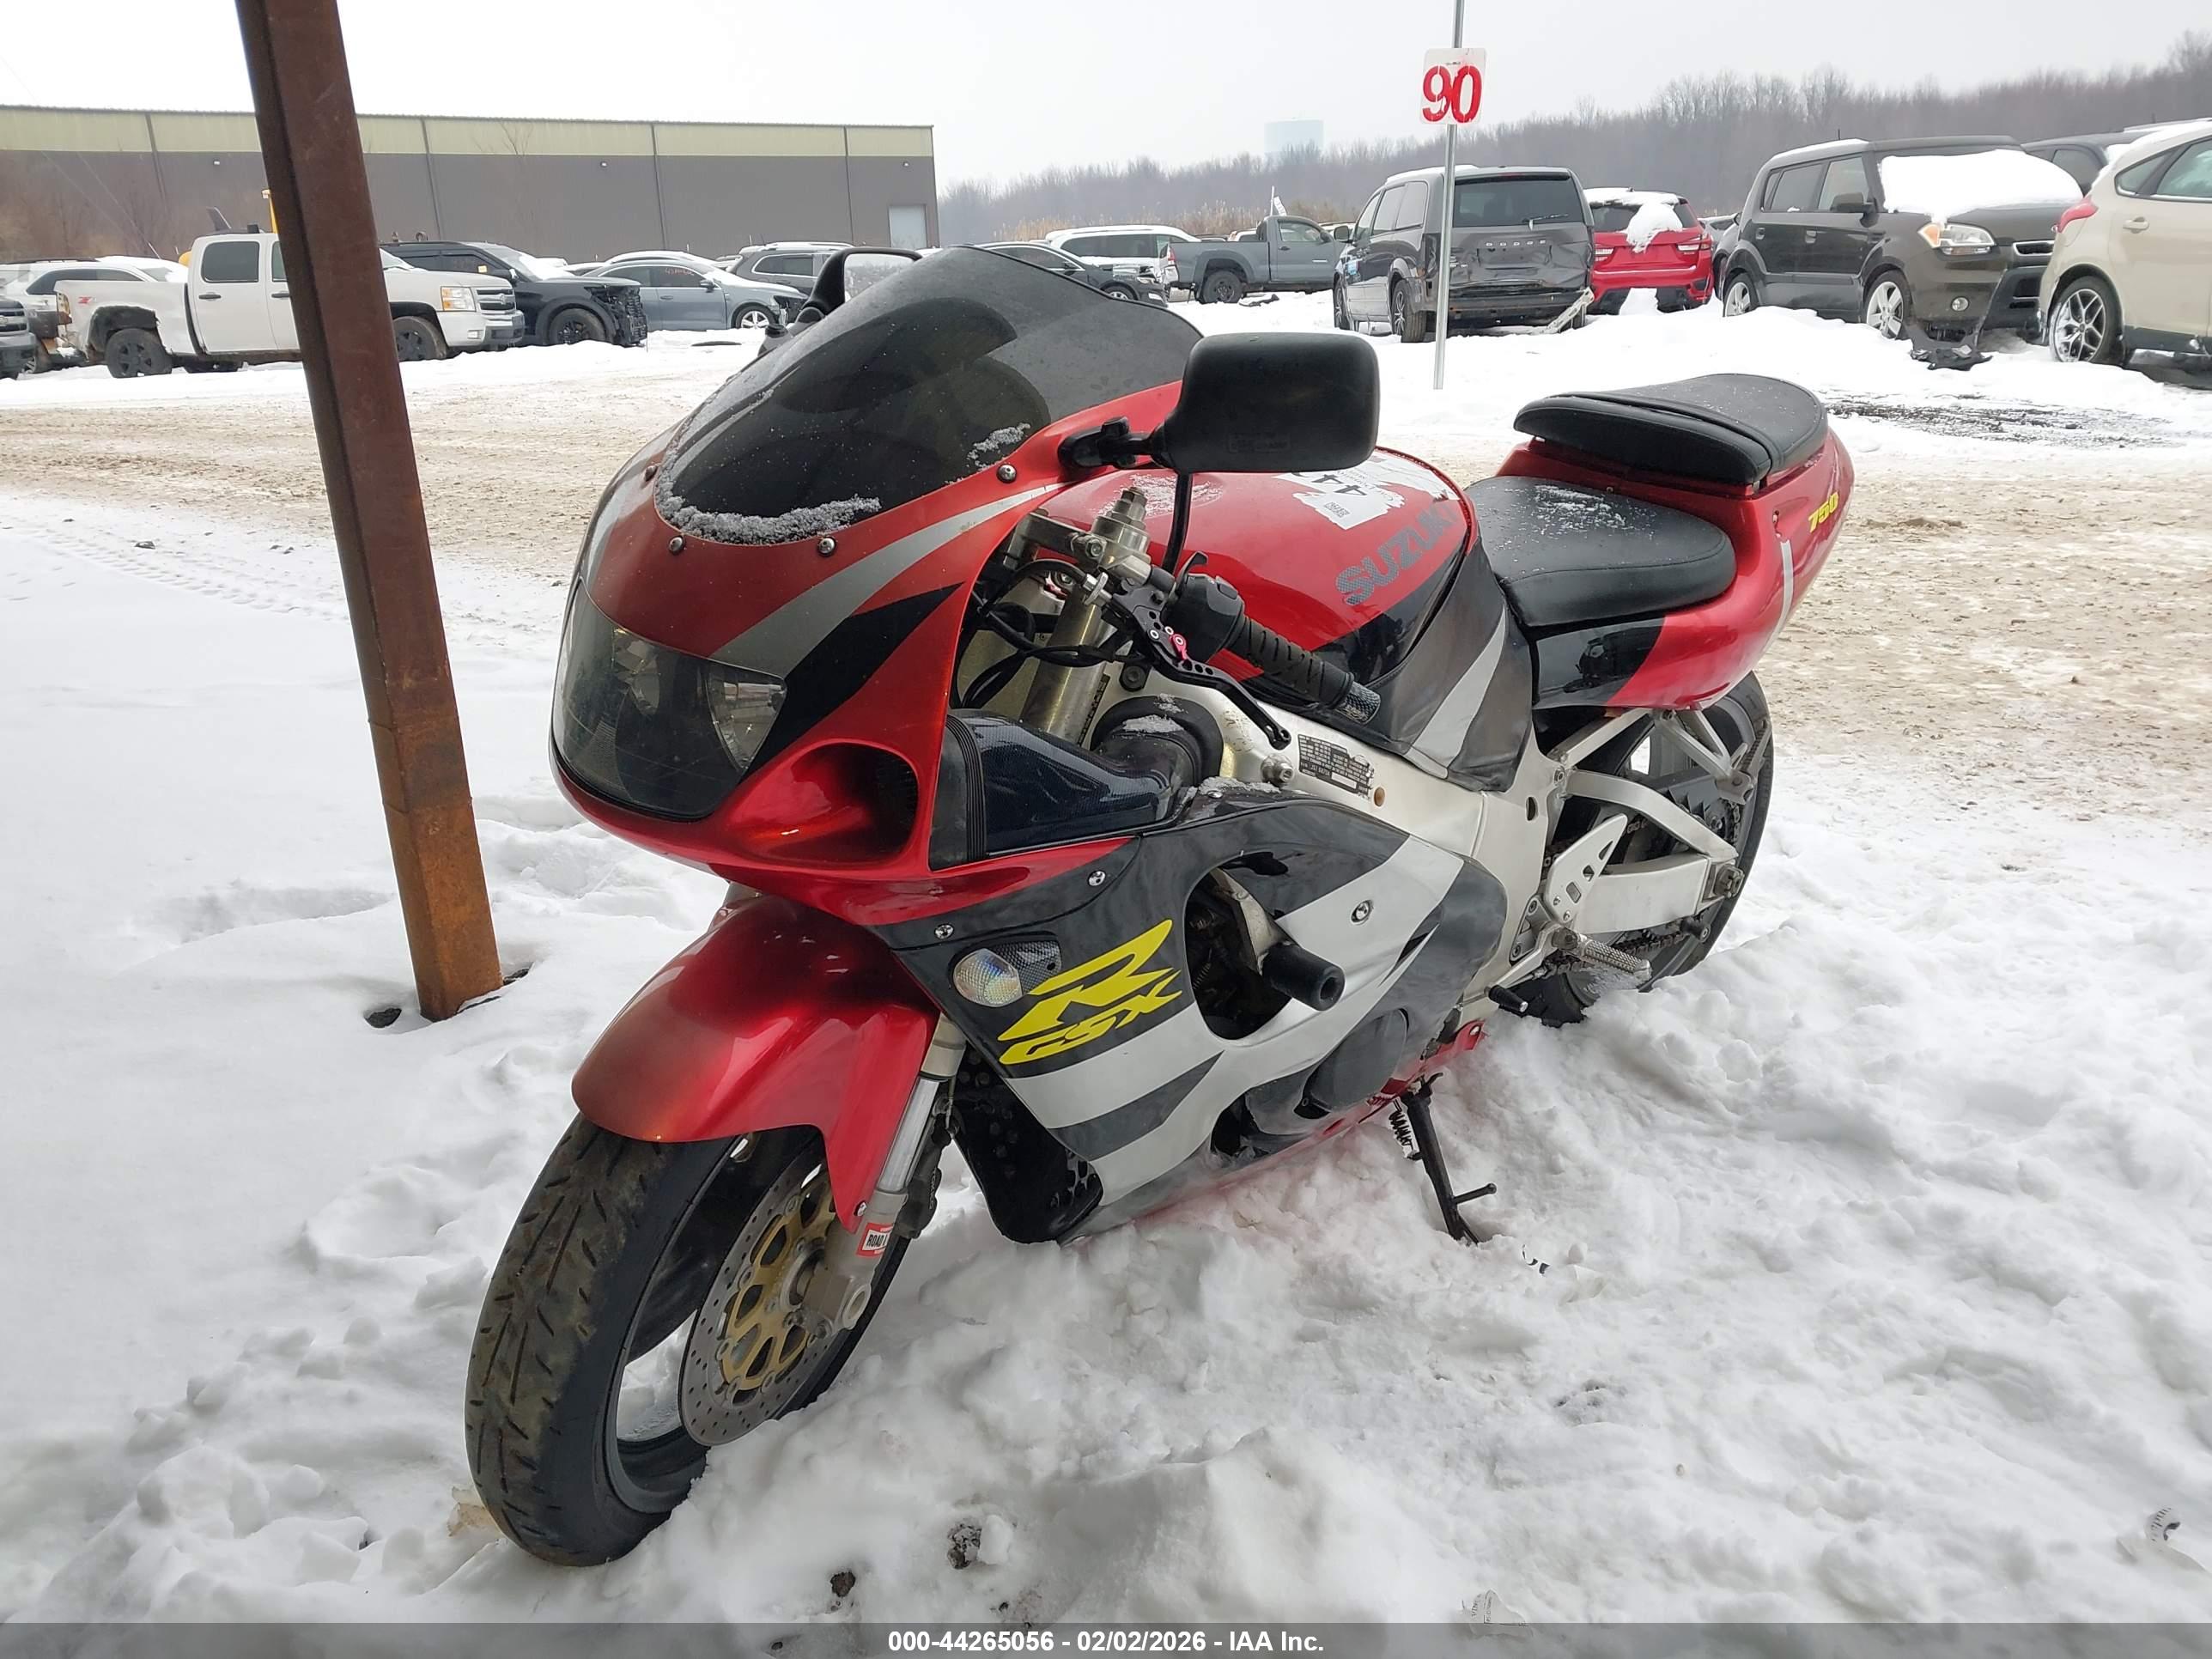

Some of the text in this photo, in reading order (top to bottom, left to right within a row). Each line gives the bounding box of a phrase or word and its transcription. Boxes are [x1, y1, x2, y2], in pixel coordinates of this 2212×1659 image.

[1422, 65, 1482, 124] 90
[1808, 491, 1839, 533] 750
[1335, 503, 1458, 606] SUZUKI
